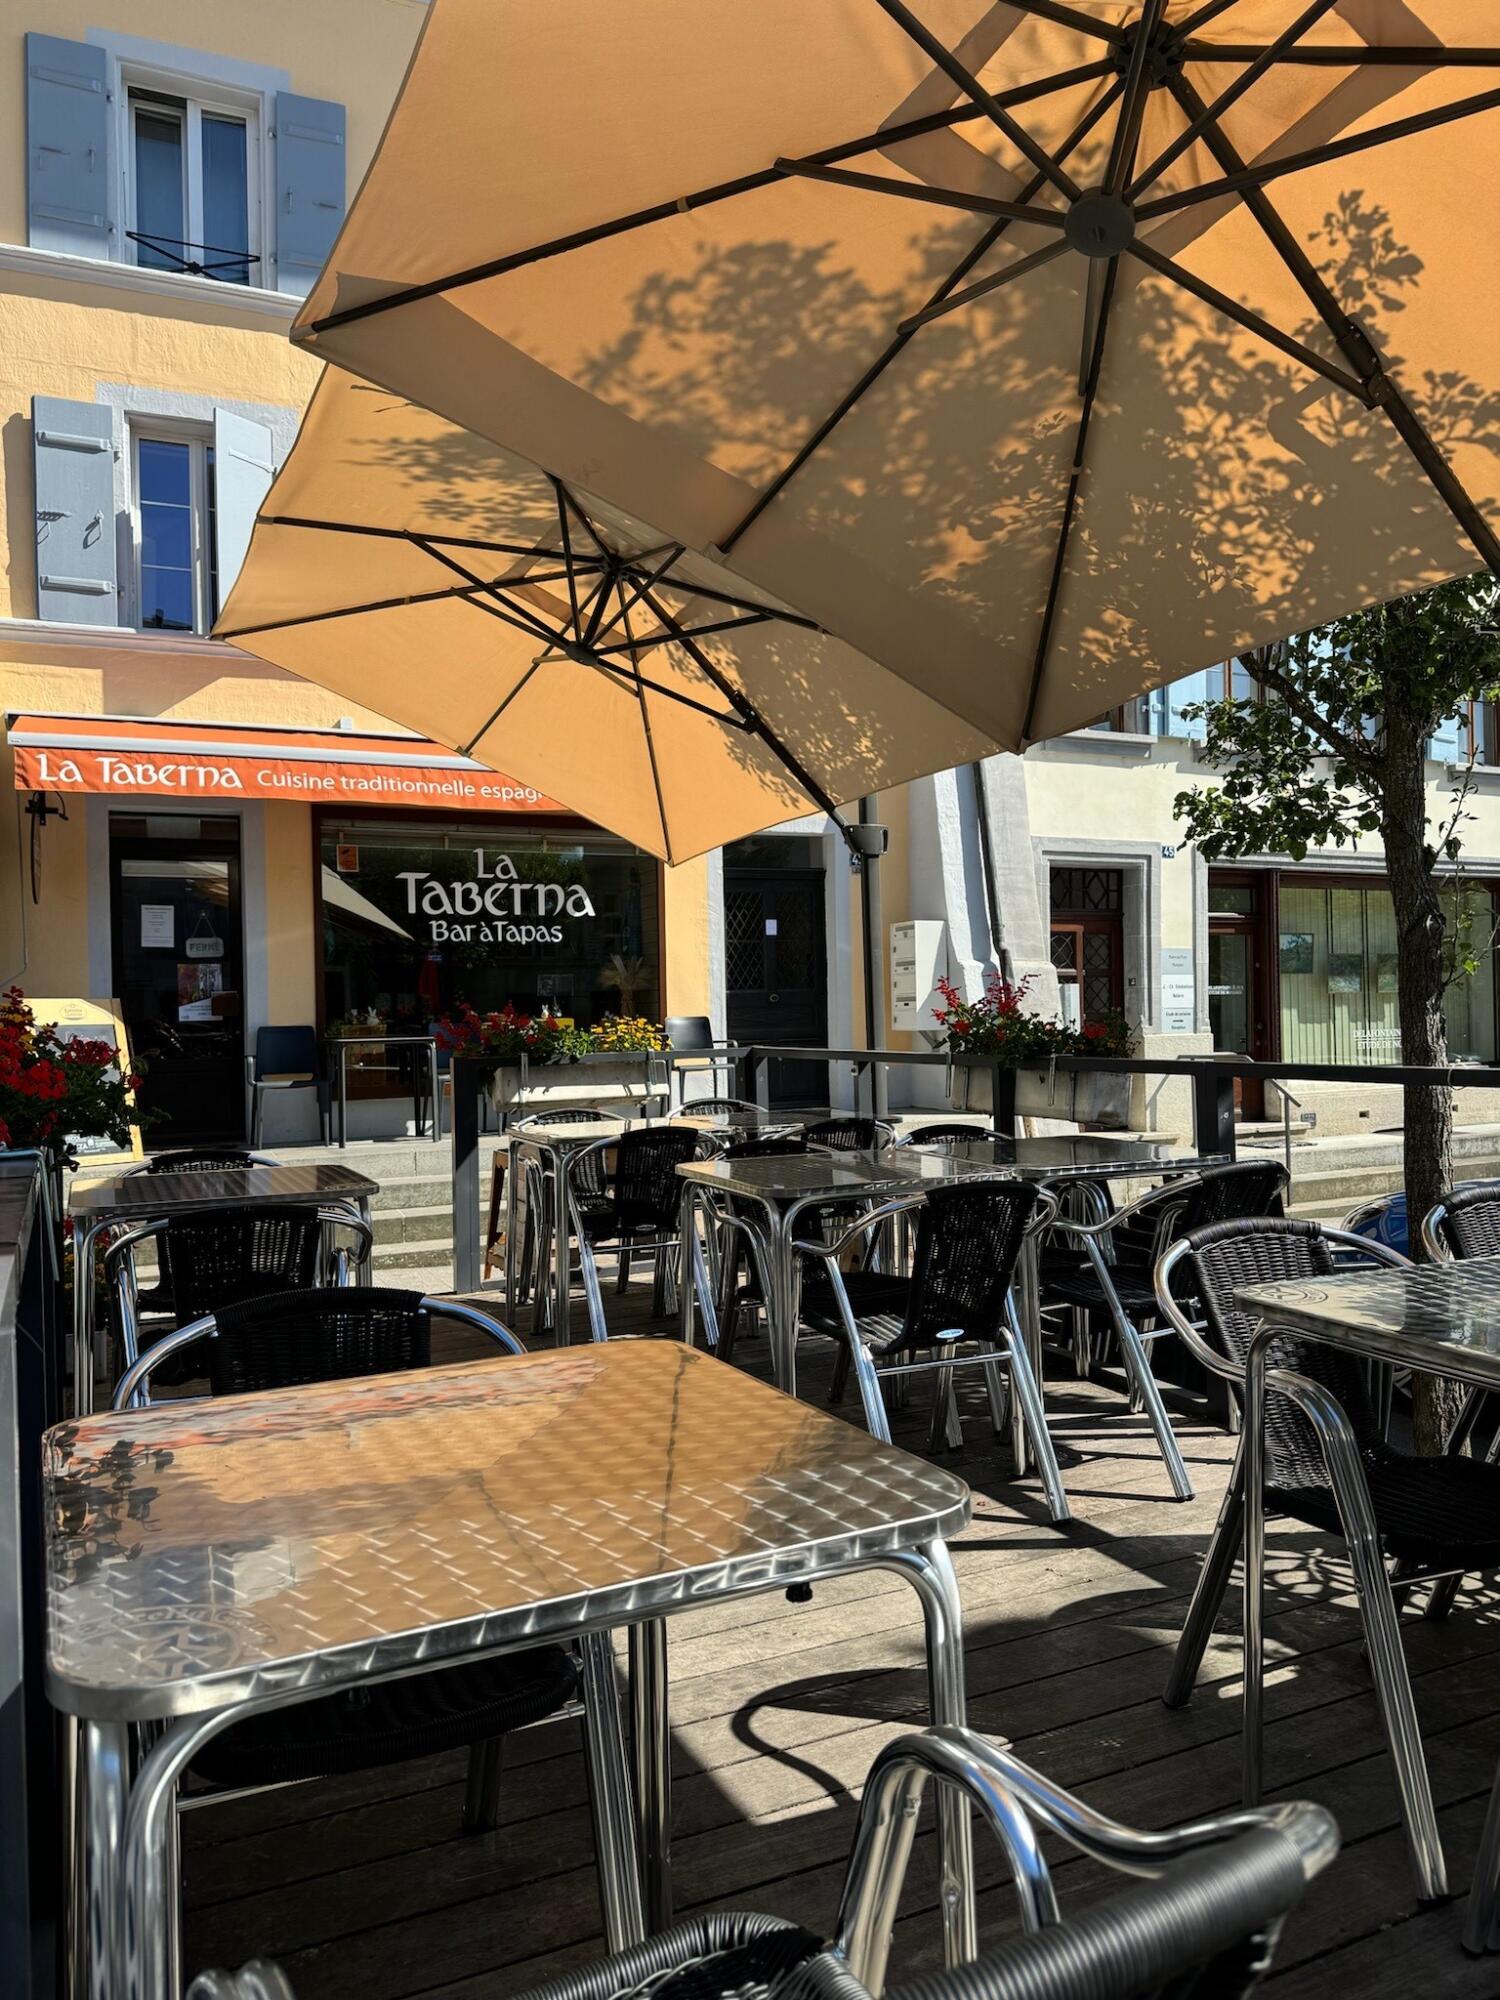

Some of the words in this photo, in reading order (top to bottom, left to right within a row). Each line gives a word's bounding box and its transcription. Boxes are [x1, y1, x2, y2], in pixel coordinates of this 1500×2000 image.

[35, 753, 84, 783] La
[256, 770, 336, 790] Cuisine
[342, 774, 477, 797] traditionnelle
[480, 785, 544, 803] espag
[1163, 846, 1174, 857] 45
[473, 848, 518, 879] La
[429, 920, 477, 942] Bar
[1353, 1028, 1402, 1038] DELAFONTAIN
